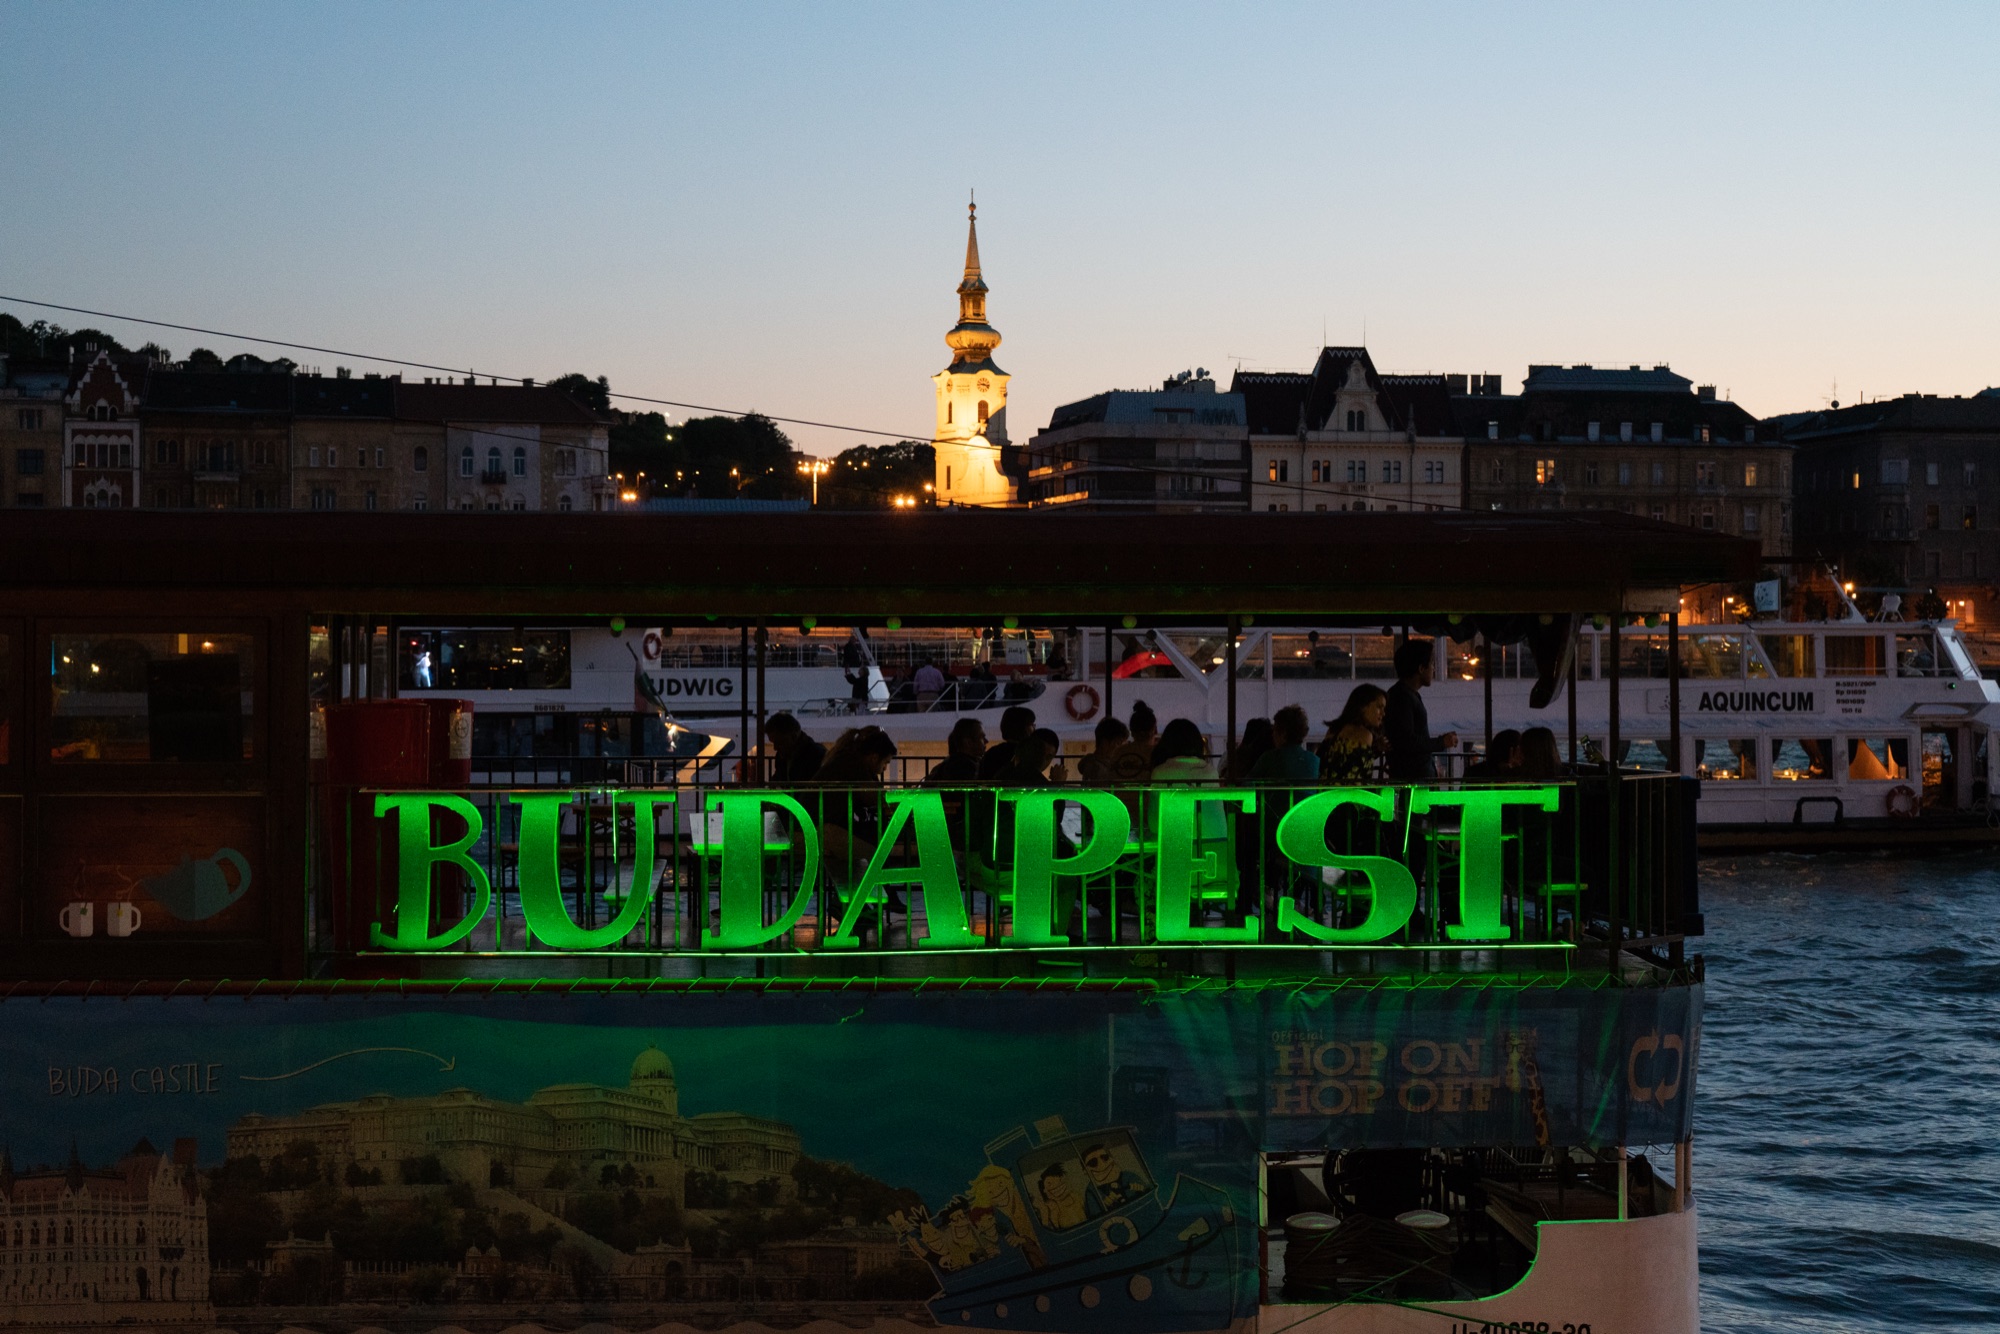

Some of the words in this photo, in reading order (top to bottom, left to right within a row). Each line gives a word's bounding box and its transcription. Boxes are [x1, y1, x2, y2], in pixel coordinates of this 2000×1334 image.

[649, 678, 734, 696] UDWIG
[1699, 692, 1814, 712] AQUINCUM
[370, 788, 1559, 949] BUDAPEST
[1274, 1041, 1388, 1076] HOP
[1401, 1038, 1486, 1075] ON
[48, 1066, 120, 1097] BUDA
[131, 1063, 223, 1094] CASTLE
[1271, 1079, 1385, 1115] HOP
[1398, 1078, 1500, 1113] OFF
